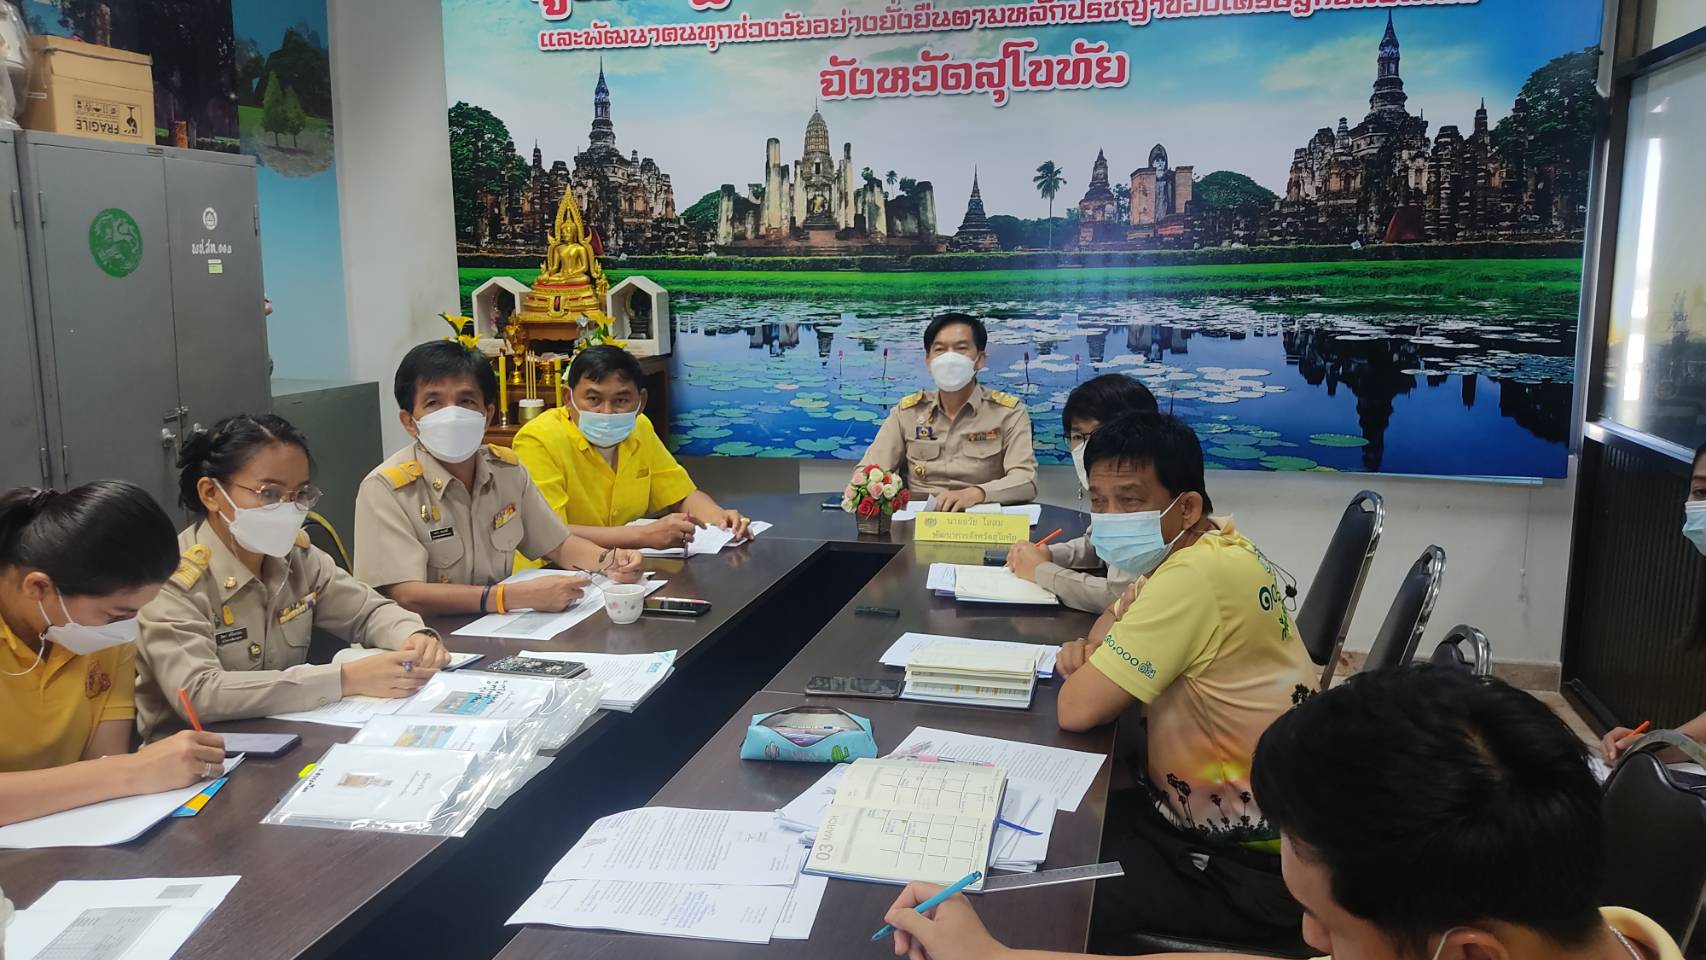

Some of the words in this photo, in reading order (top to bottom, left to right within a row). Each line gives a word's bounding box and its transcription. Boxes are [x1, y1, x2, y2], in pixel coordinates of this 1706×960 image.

[820, 41, 1128, 102] จังหวัดสุโขทัย
[76, 119, 119, 134] FRAGILE
[816, 844, 833, 861] 03
